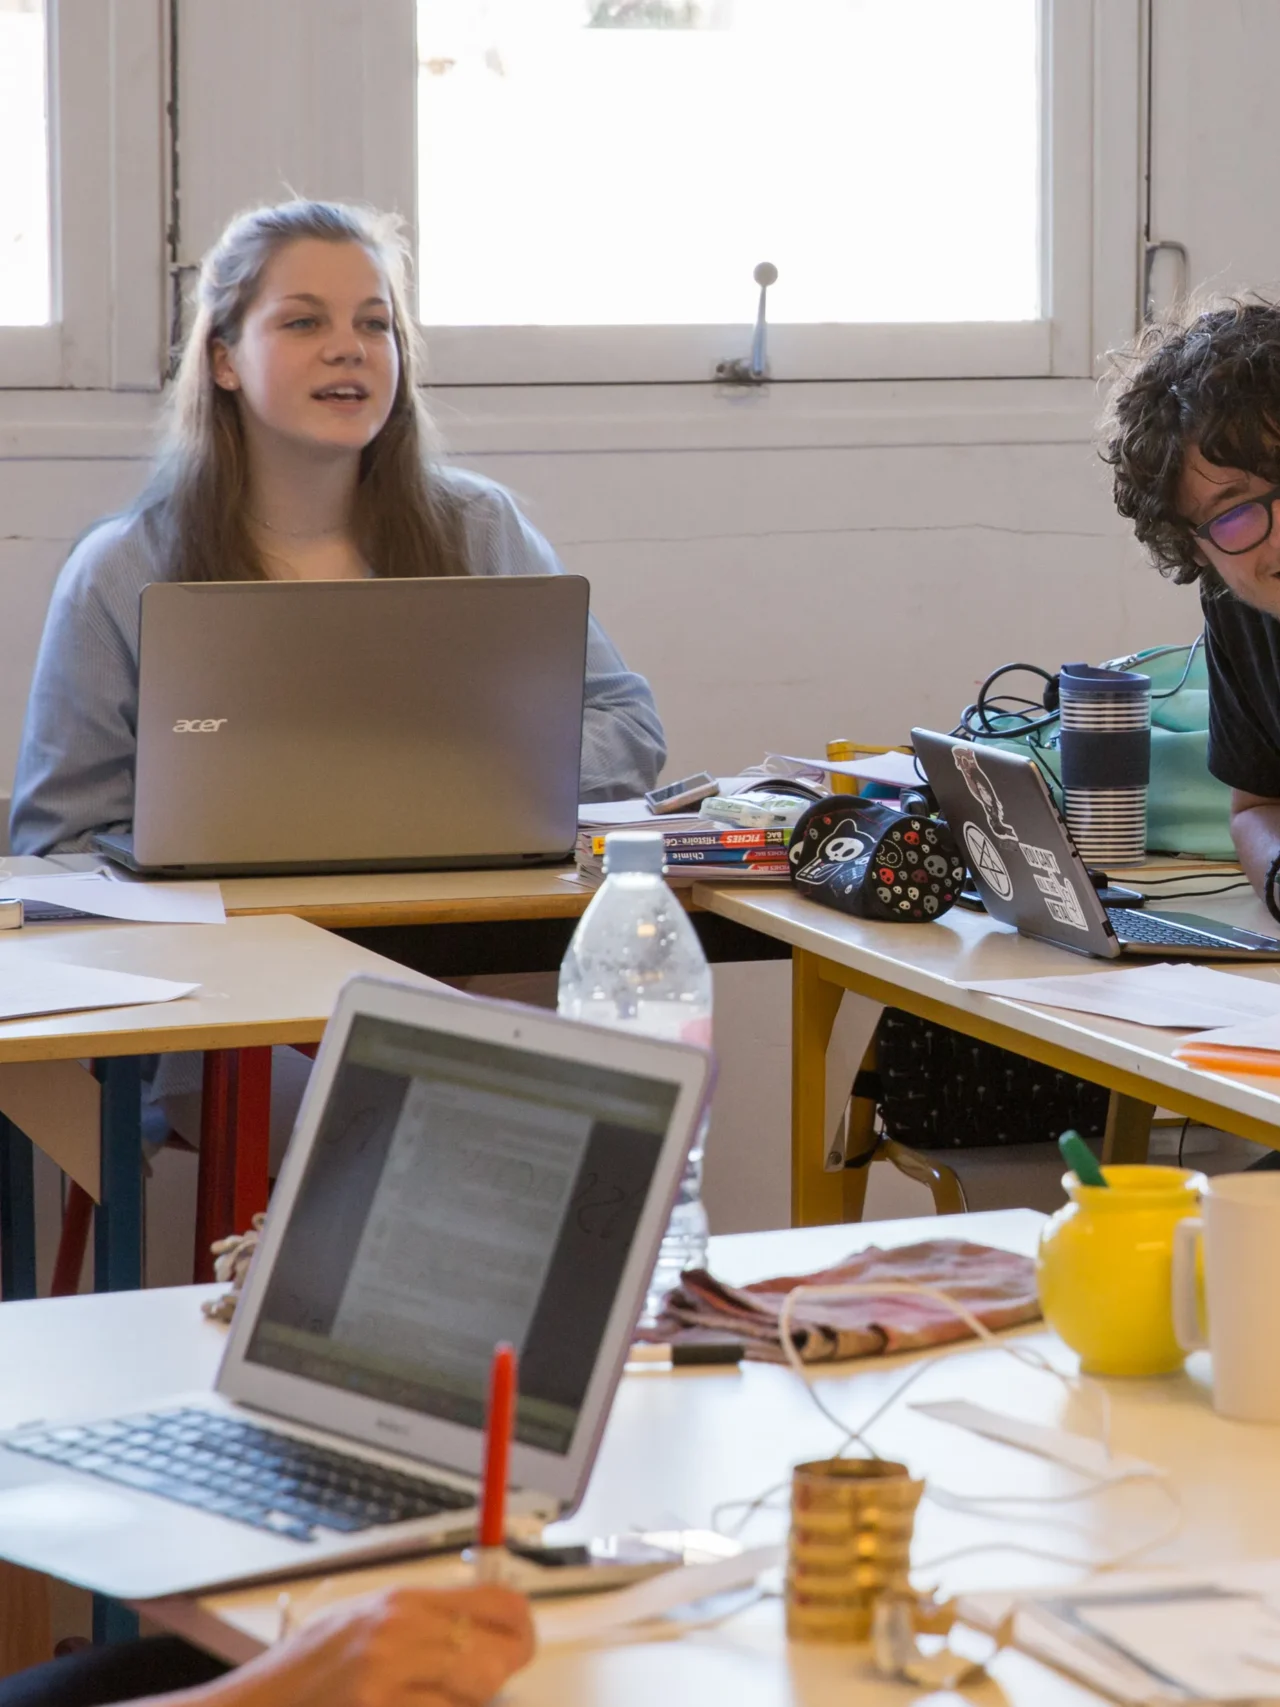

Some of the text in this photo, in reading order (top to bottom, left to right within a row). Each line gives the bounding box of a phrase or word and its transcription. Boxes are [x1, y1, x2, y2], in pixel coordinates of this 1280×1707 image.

[172, 718, 228, 733] acer
[726, 834, 760, 844] FICHES
[672, 852, 704, 861] Chimie
